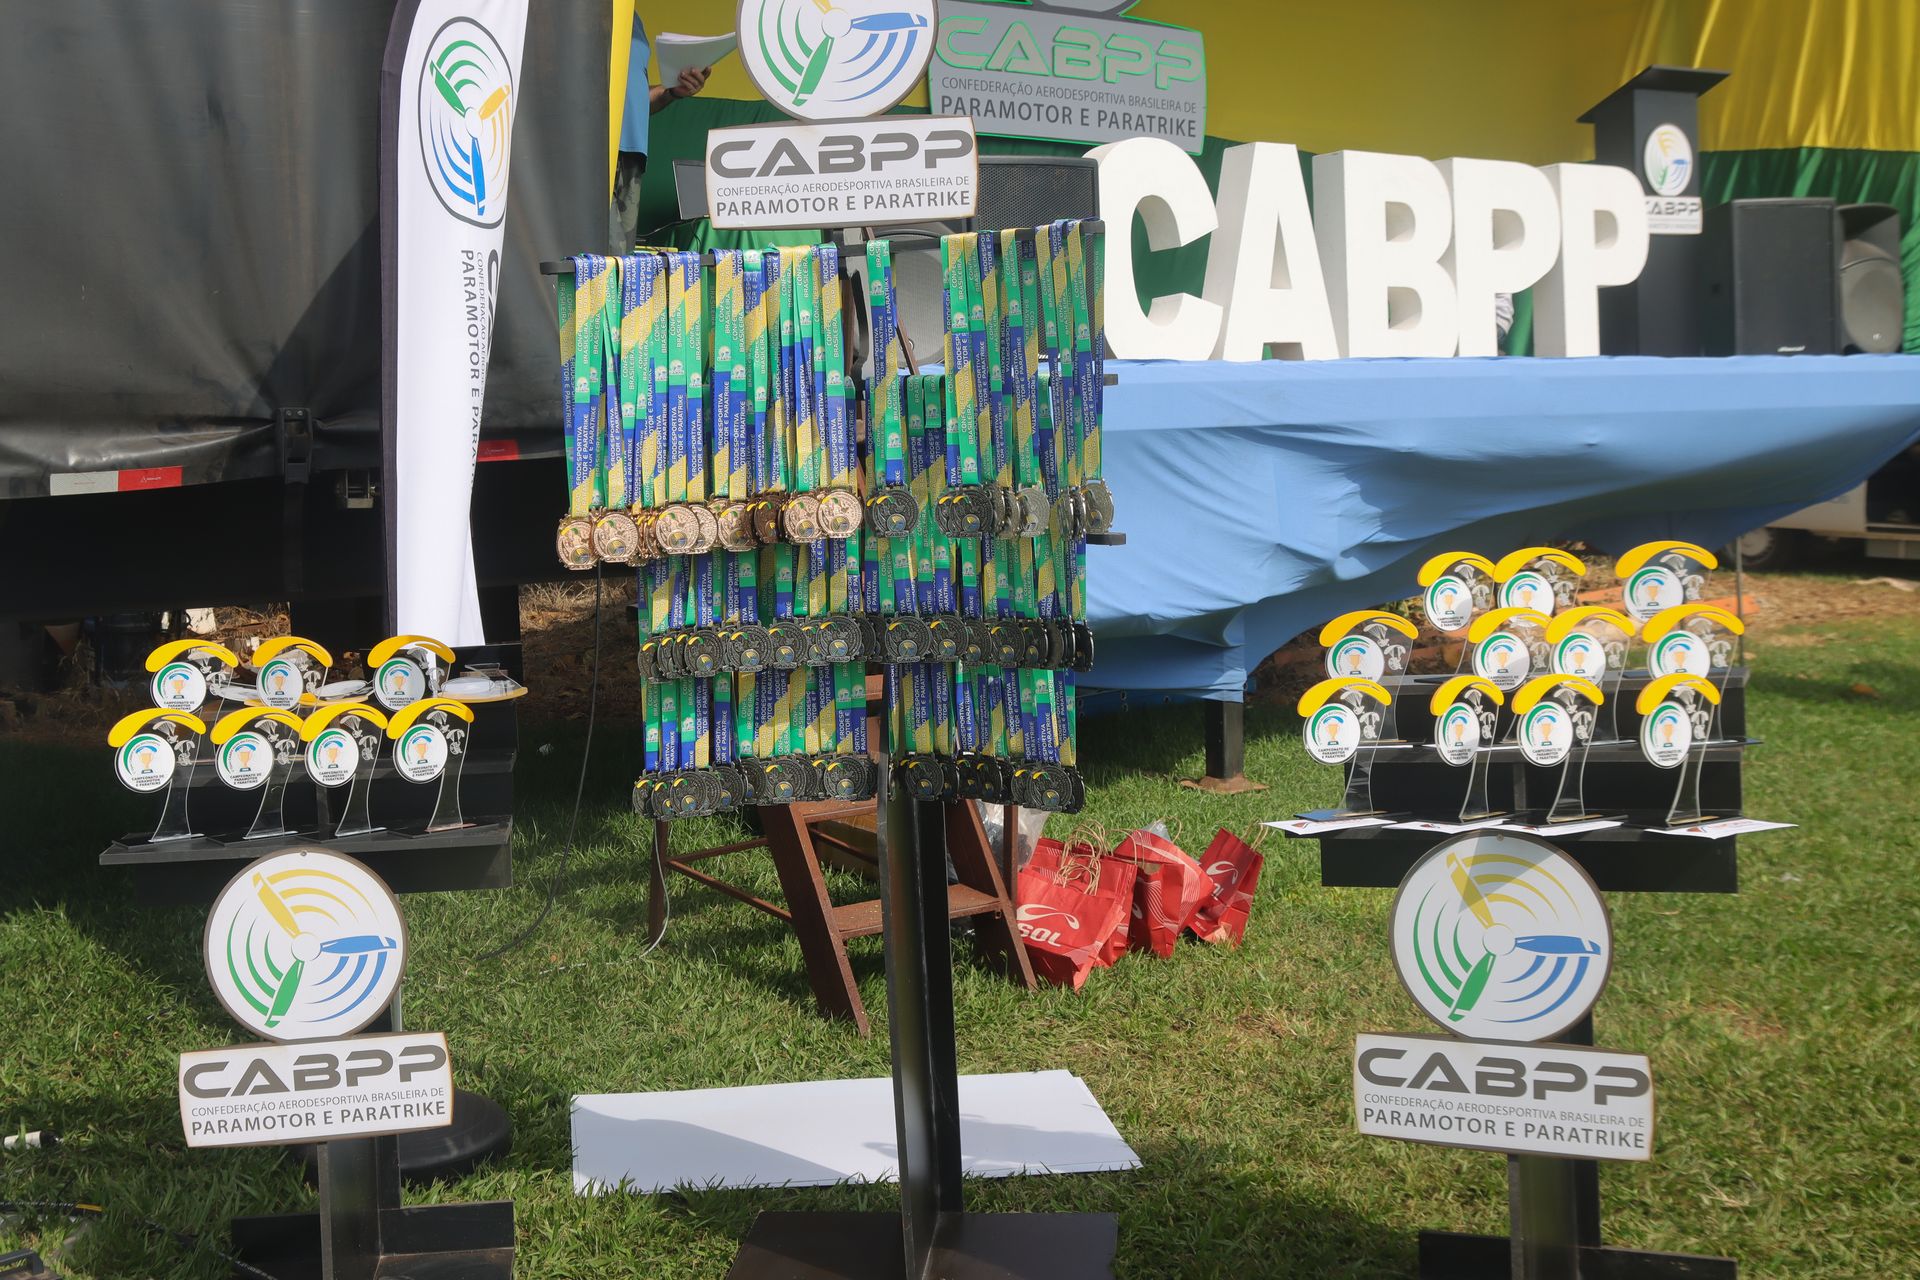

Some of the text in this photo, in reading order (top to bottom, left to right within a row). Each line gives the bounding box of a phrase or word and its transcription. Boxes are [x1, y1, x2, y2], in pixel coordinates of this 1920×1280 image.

[936, 16, 1202, 90] CABPP
[941, 76, 1197, 113] CONFEDERAÇÃO AERODESPORTIVA BRASILEIRA DE
[941, 95, 1197, 138] PARAMOTOR E PARATRIKE
[710, 130, 974, 179] CABPP
[716, 175, 969, 198] CONFEDERAÇÃO AERODESPORTIVA BRASILEIRA DE
[716, 191, 971, 216] PARAMOTOR E PARATRIKE
[1098, 136, 1650, 360] CABPP
[461, 249, 480, 380] PARAMOTOR
[471, 387, 480, 398] E
[1085, 362, 1093, 401] PARATRIKE
[831, 419, 839, 479] AERODESPORTIVA
[1017, 922, 1064, 947] SOL
[183, 1045, 447, 1098] CABPP
[1358, 1048, 1650, 1105] CABPP
[191, 1087, 444, 1117] CONFEDERAÇÃO AERODESPORTIVA BRASILEIRA DE
[192, 1101, 446, 1135] PARAMOTOR E PARATRIKE
[1364, 1094, 1645, 1128] CONFEDERAÇÃO AERODESPORTIVA BRASILEIRA DE
[1363, 1107, 1645, 1148] PARAMOTOR E PARATRIKE
